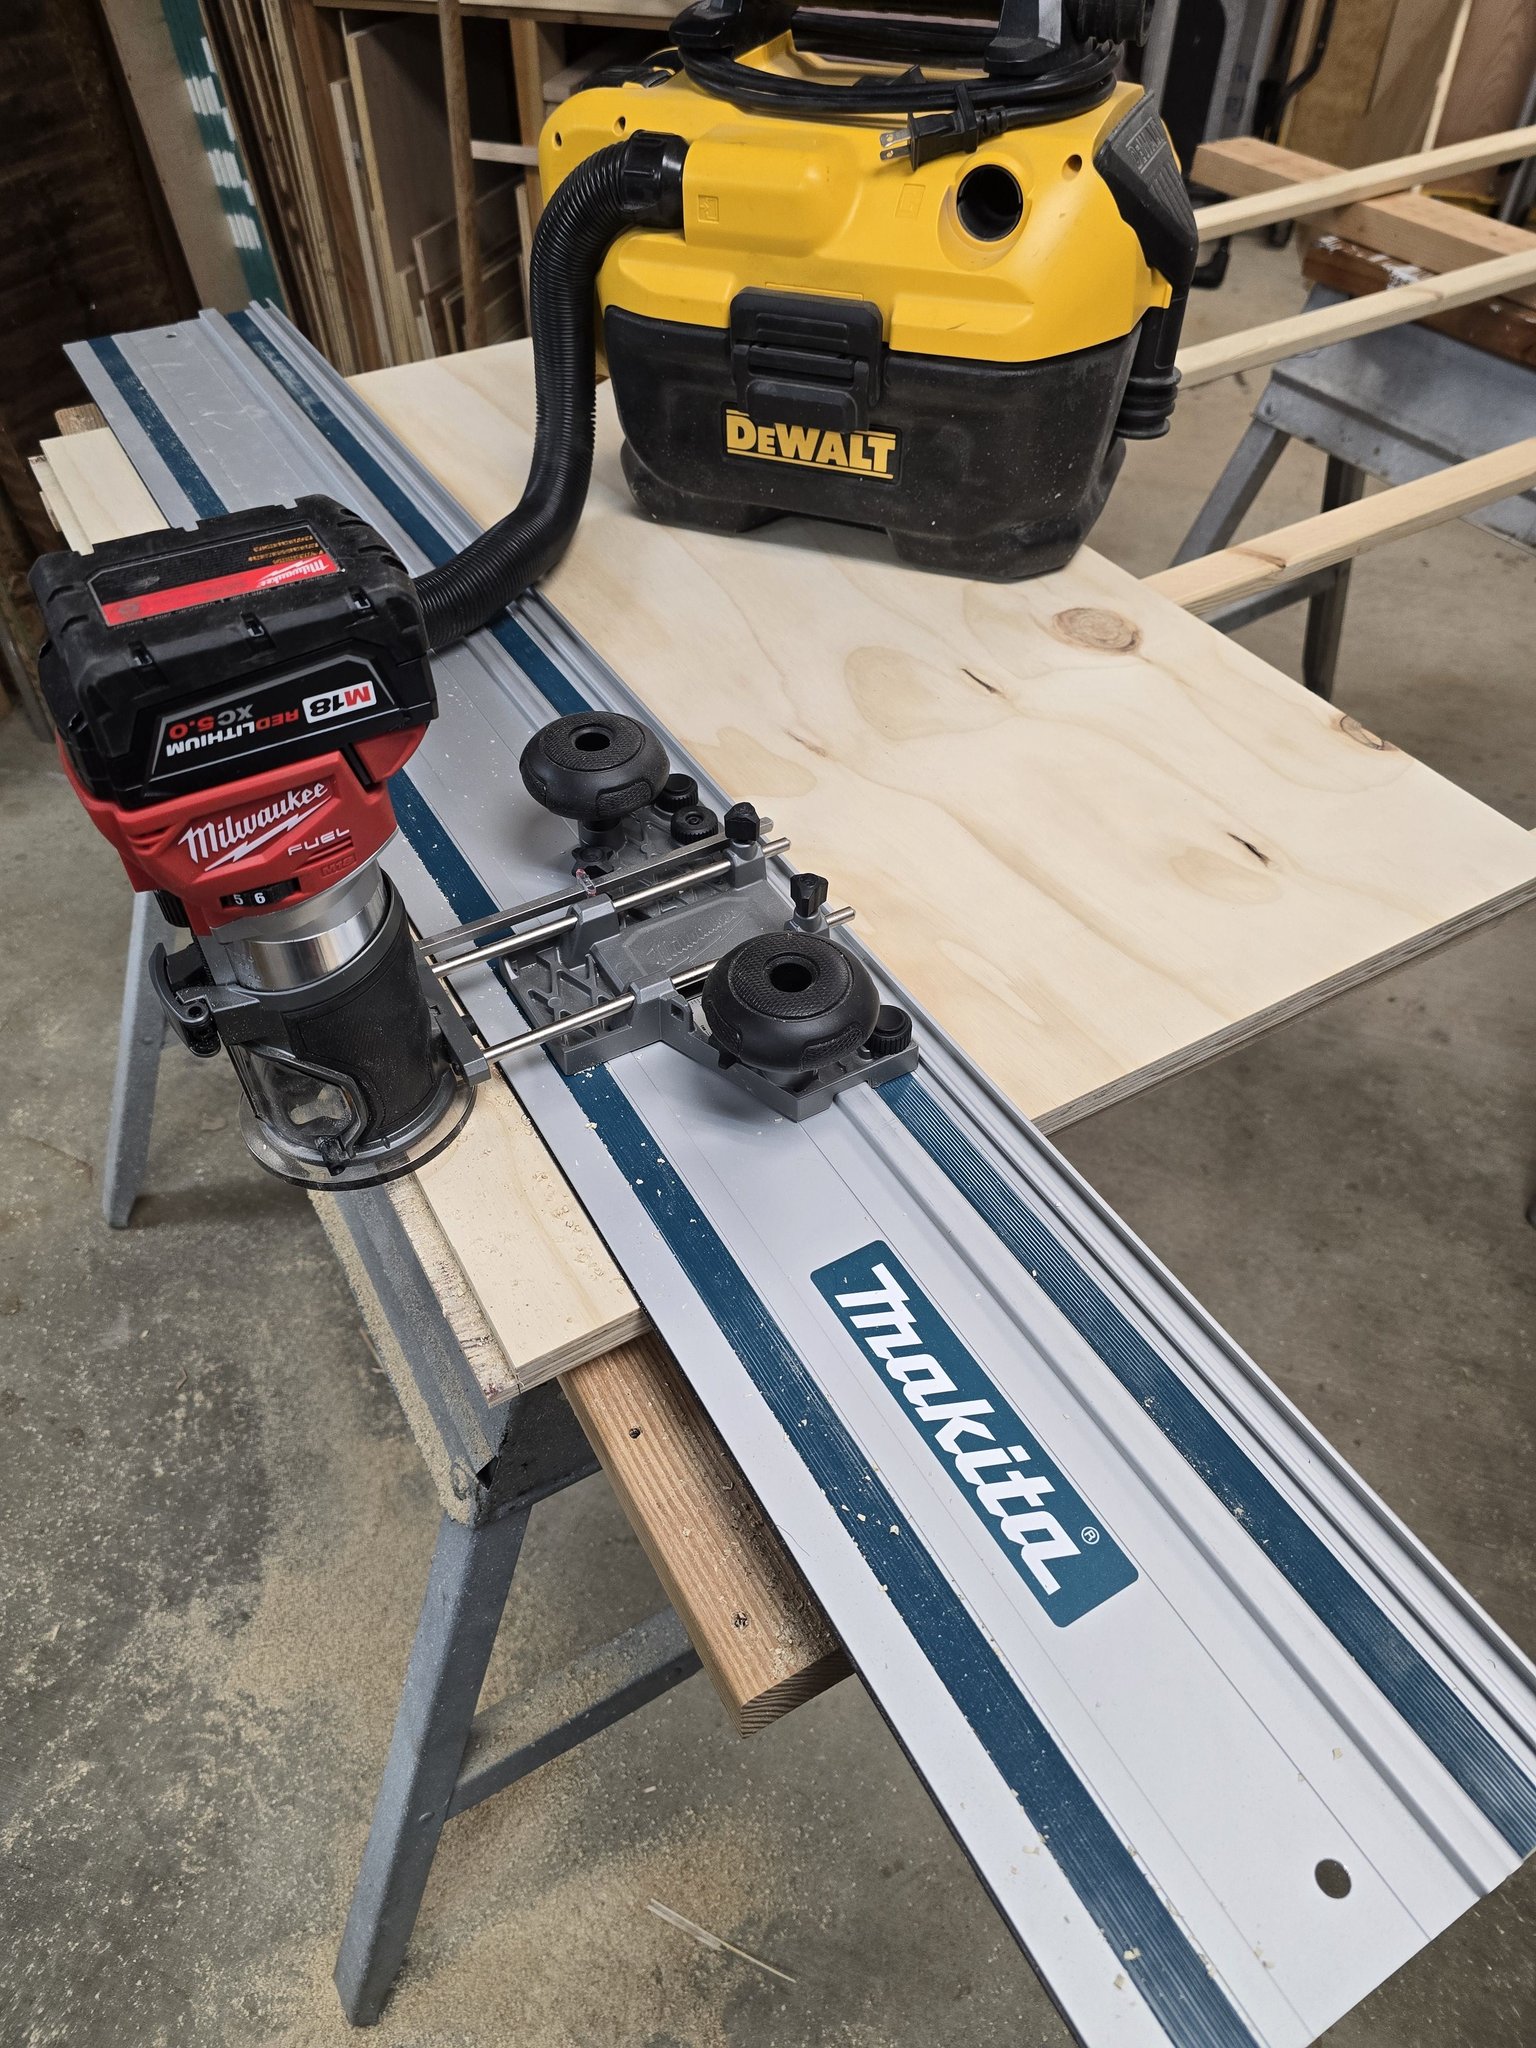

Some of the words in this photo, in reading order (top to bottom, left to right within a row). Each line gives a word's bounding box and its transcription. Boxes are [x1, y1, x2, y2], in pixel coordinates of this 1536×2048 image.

[726, 414, 896, 473] DEWALT
[258, 559, 330, 587] Milwaukee
[309, 685, 372, 717] M18
[178, 782, 329, 864] Milwaukee
[287, 828, 350, 856] FUEL
[233, 894, 244, 905] 5
[254, 892, 266, 904] 6
